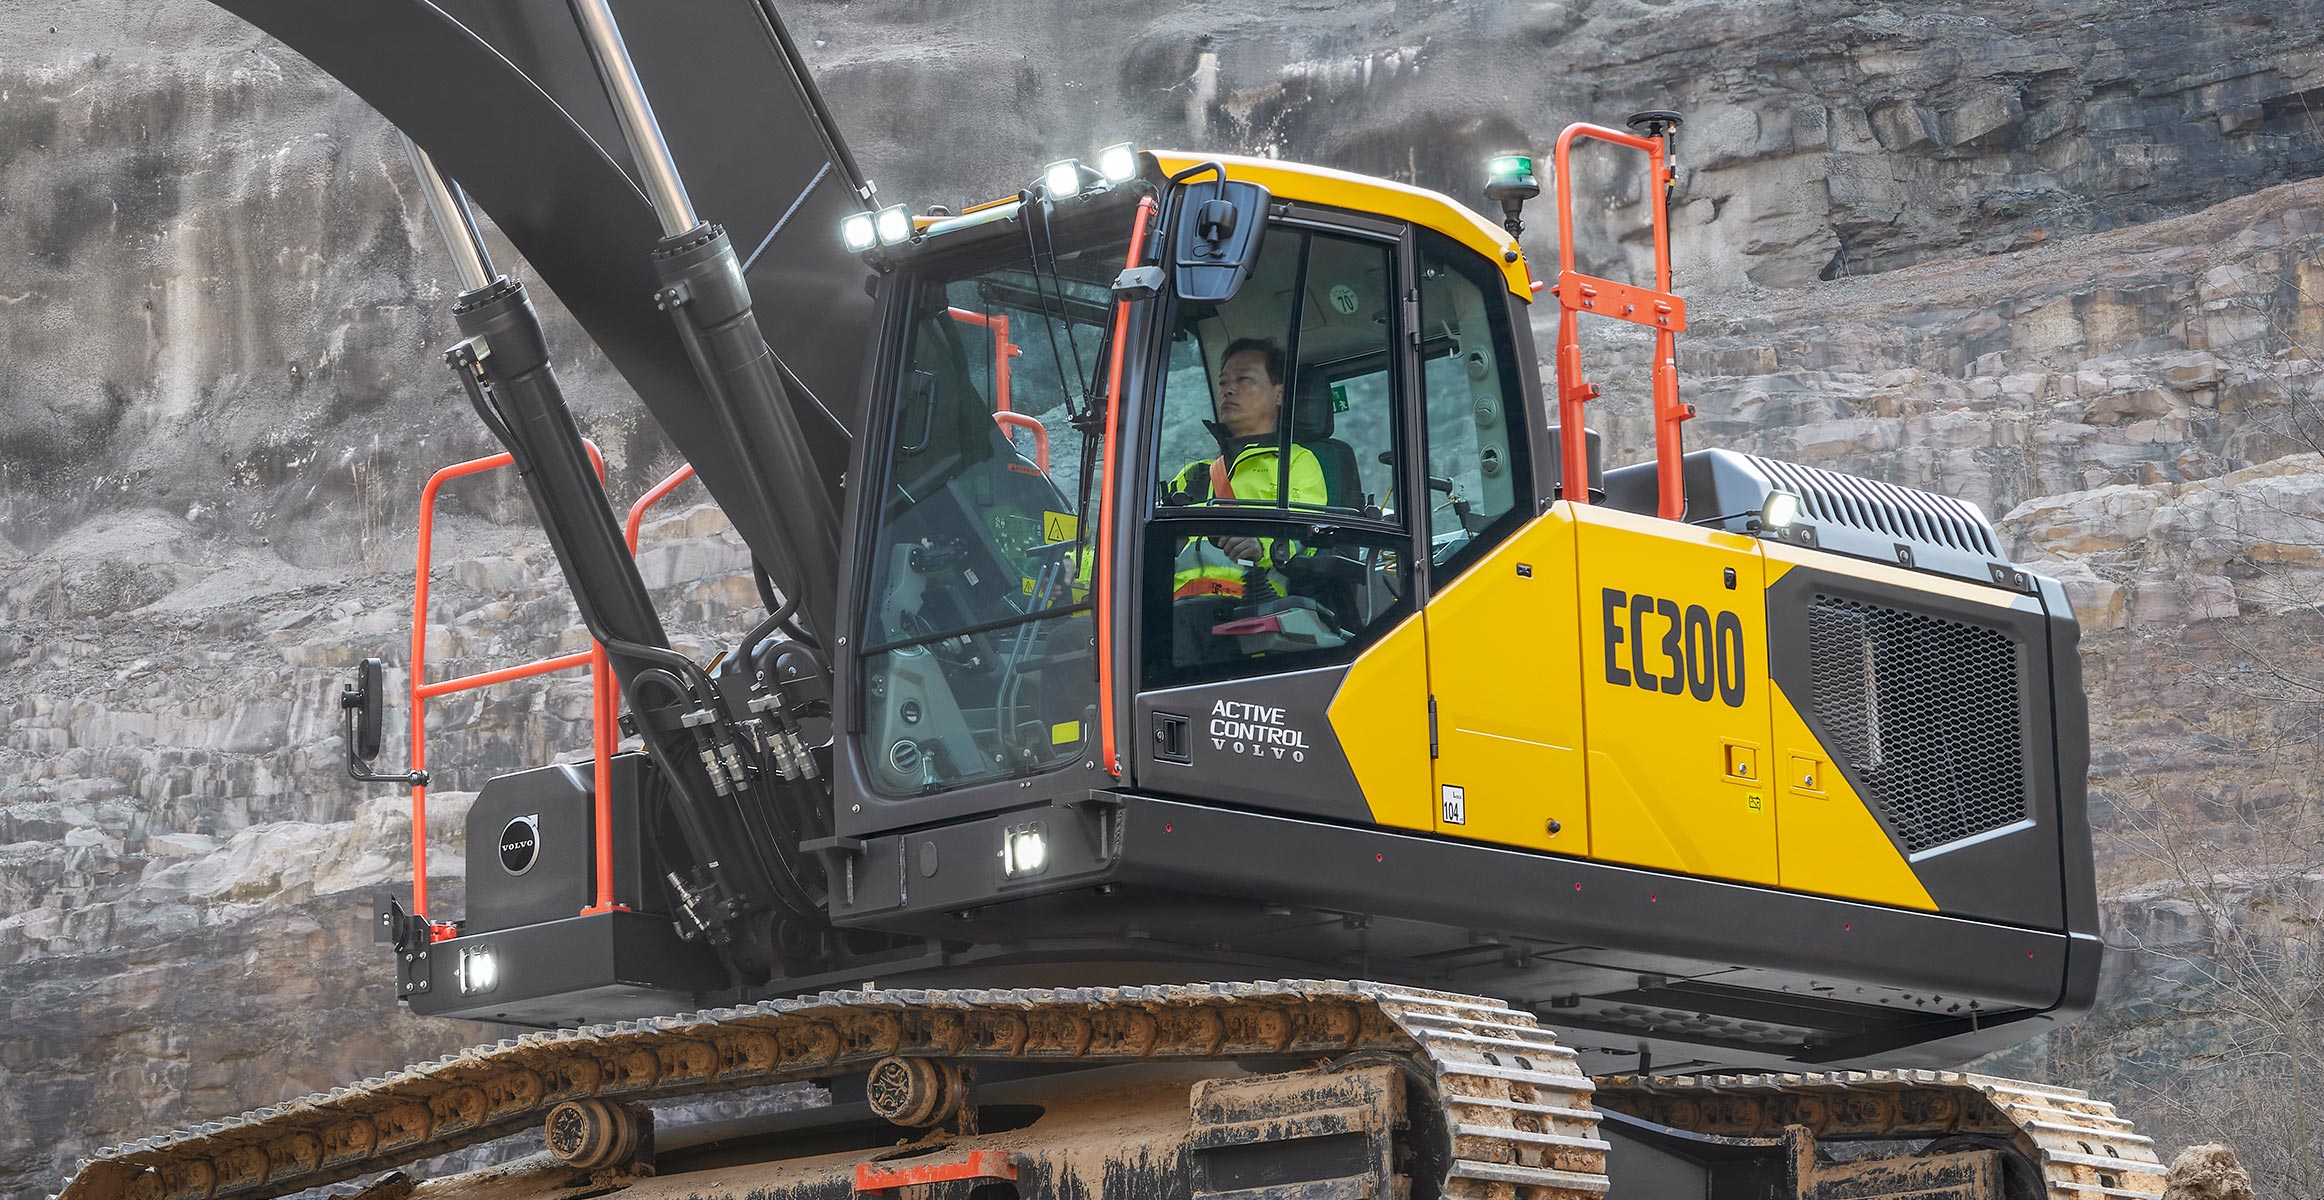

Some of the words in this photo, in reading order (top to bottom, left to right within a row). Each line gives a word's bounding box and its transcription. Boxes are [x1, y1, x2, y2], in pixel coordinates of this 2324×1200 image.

[1602, 587, 1746, 708] EC300
[1211, 699, 1286, 726] ACTIVE
[1210, 718, 1310, 749] CONTROL
[1211, 737, 1305, 763] VOLVO
[1444, 801, 1460, 822] 104
[501, 839, 534, 852] VOLVO
